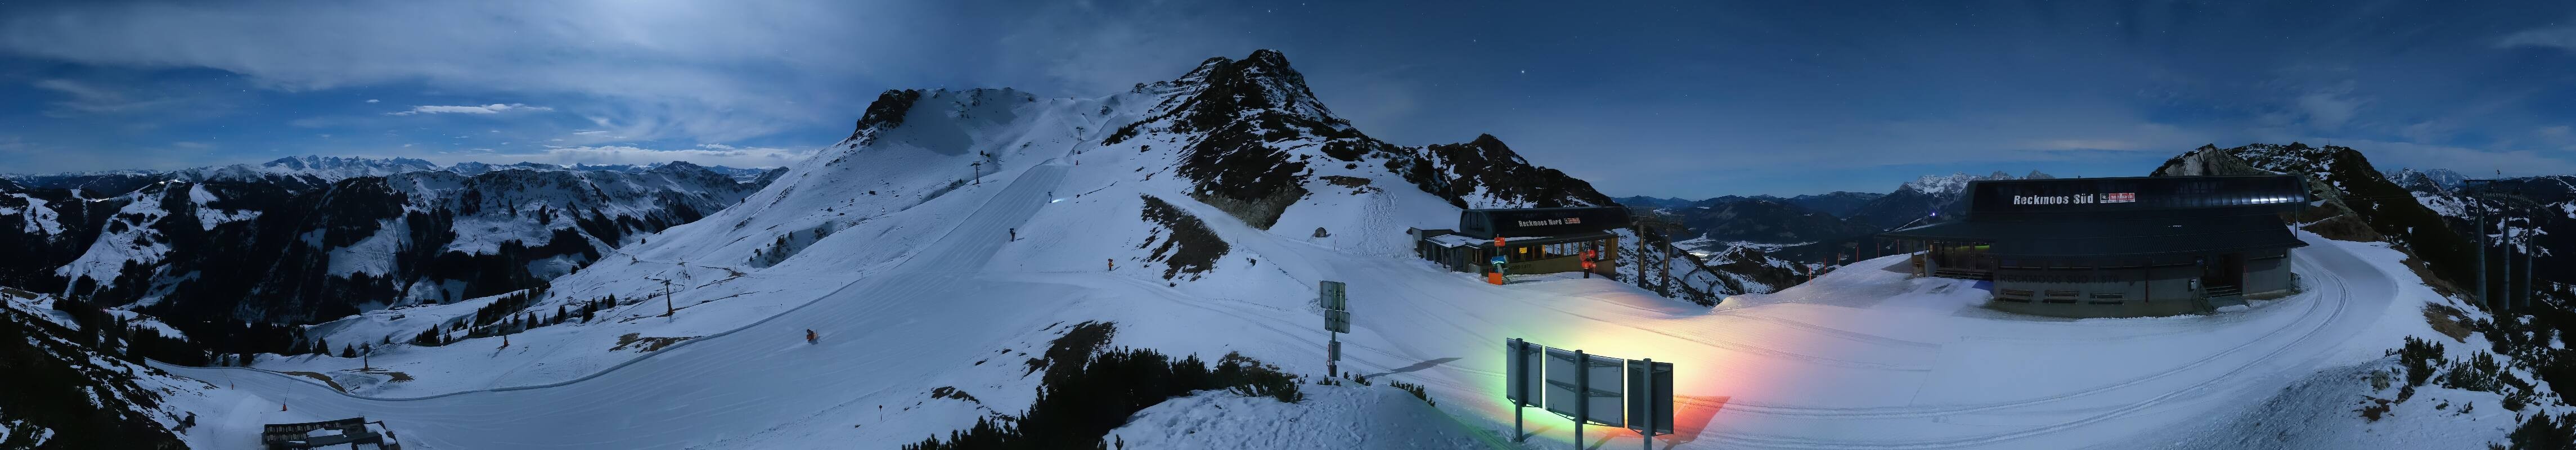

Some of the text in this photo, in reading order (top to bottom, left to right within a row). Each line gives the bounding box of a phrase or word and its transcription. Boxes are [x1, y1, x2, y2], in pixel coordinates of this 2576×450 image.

[2014, 193, 2093, 205] Reckmoos Süd
[1999, 274, 2061, 284] RECKMOOS
